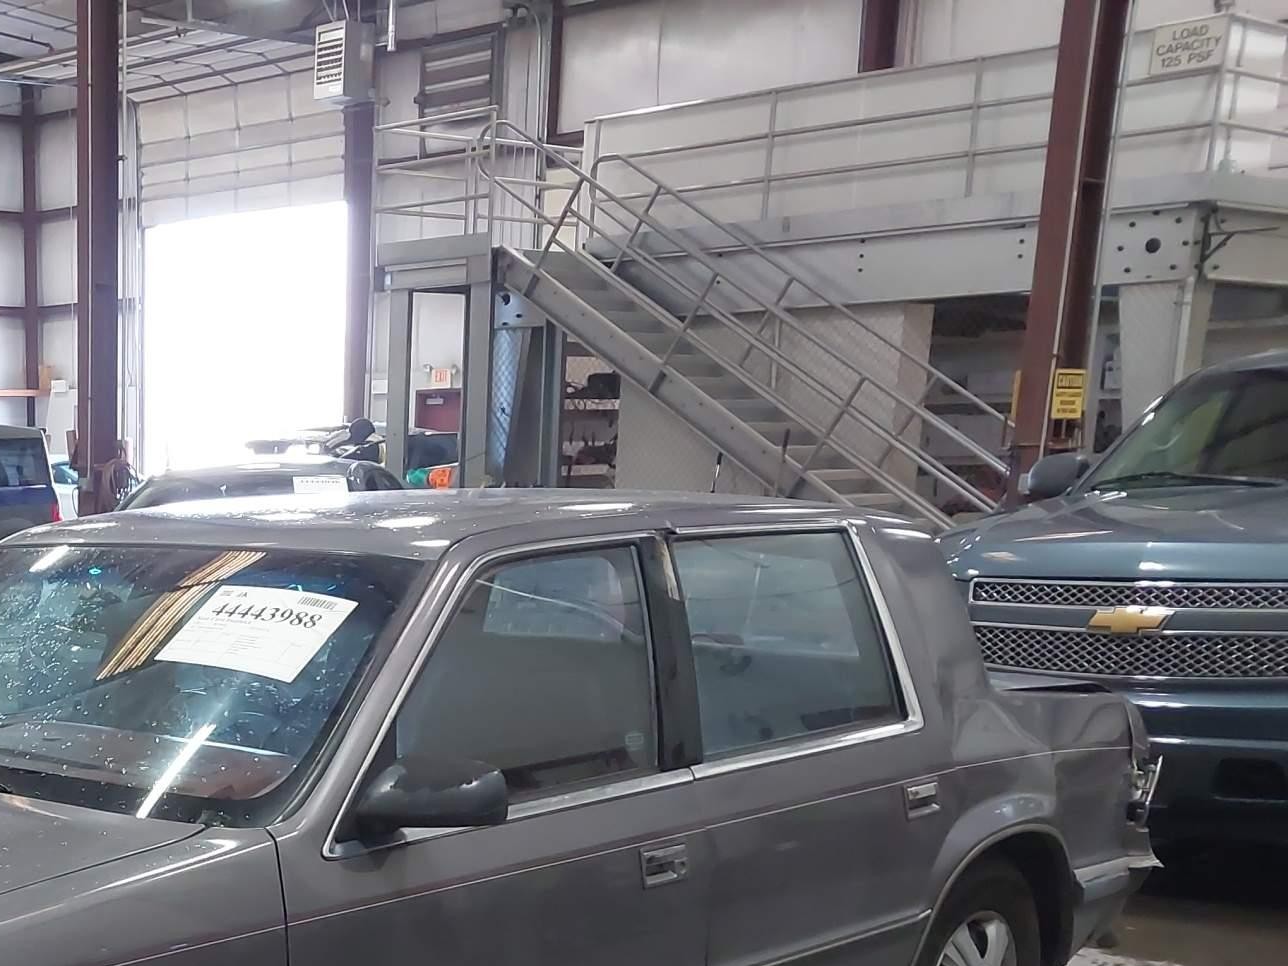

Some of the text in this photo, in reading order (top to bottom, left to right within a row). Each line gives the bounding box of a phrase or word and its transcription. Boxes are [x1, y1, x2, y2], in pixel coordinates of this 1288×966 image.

[1173, 24, 1209, 40] LOAD
[1156, 35, 1223, 56] CAPACITY
[1161, 49, 1214, 68] 125 PSF
[435, 370, 448, 382] EXIT
[212, 603, 322, 628] 44443988
